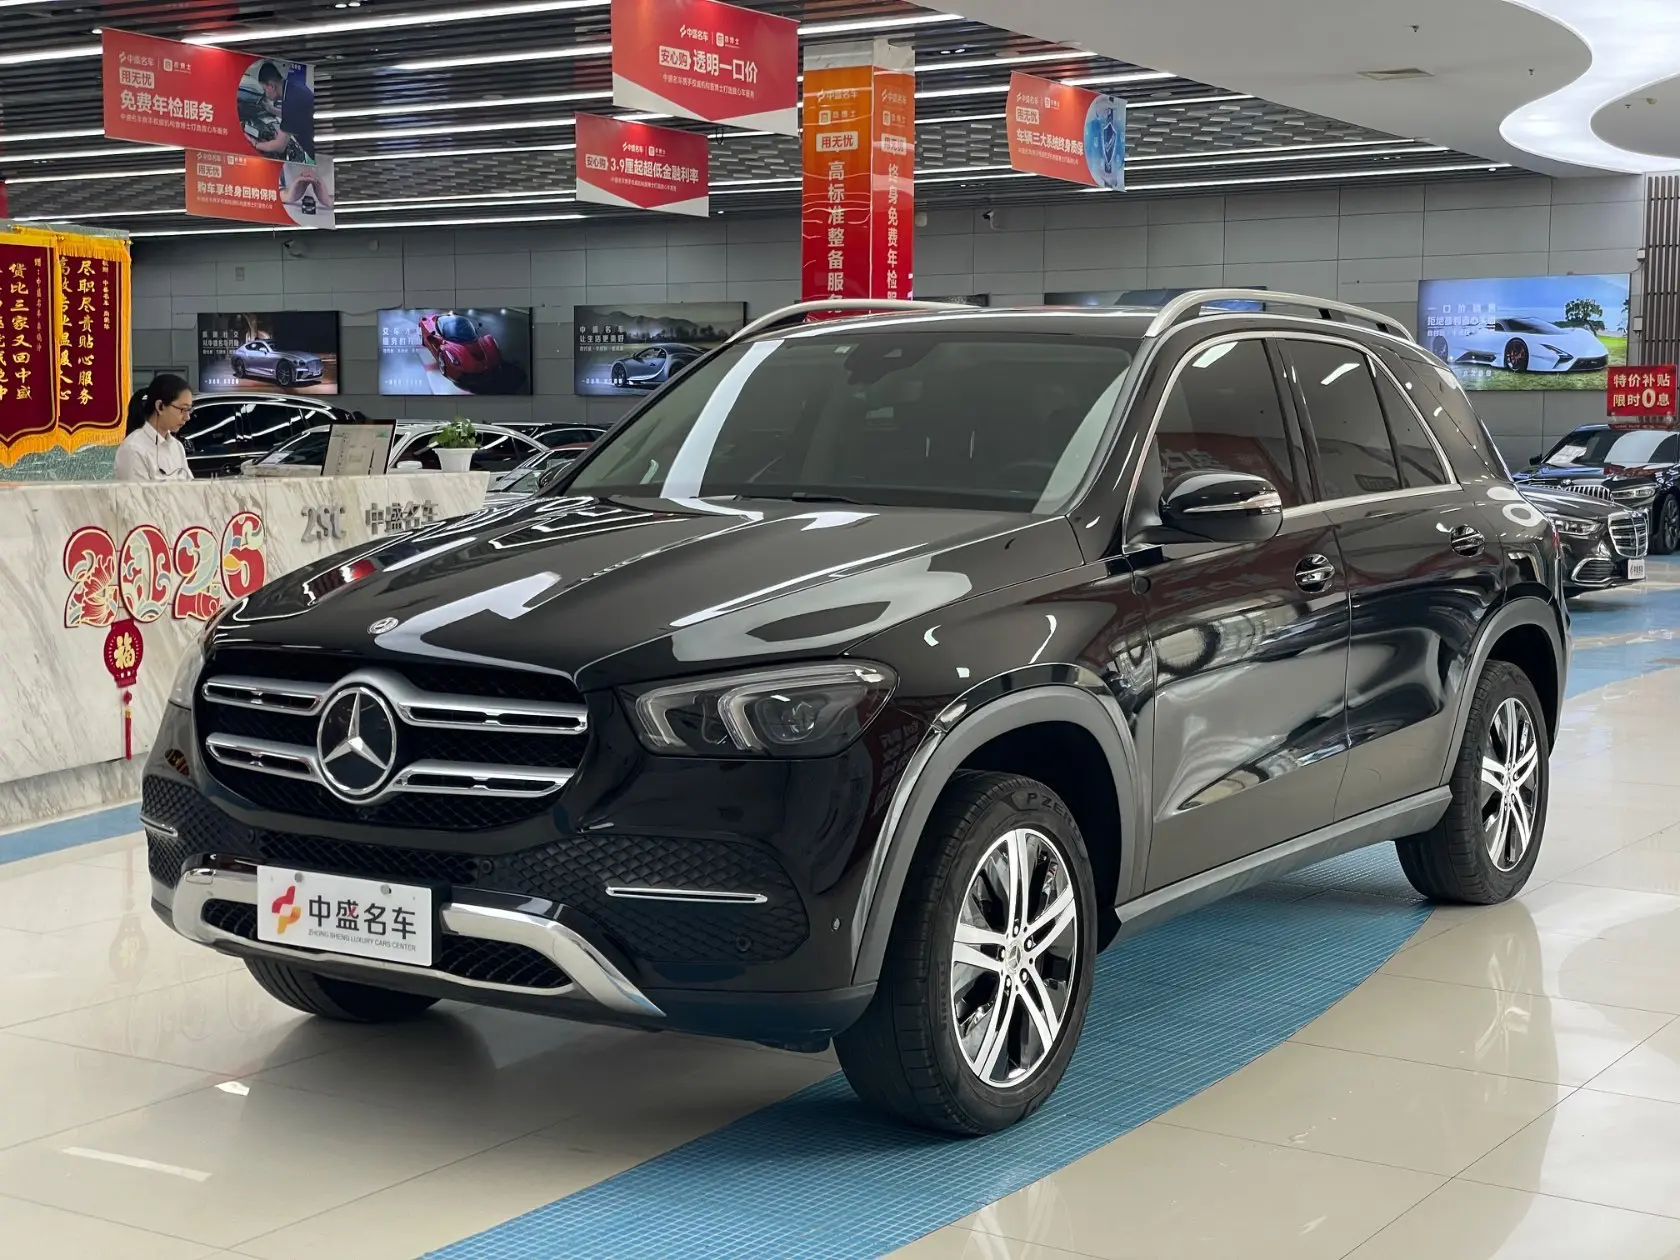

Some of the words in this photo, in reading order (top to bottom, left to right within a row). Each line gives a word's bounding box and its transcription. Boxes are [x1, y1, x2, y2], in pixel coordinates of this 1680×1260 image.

[121, 70, 152, 86] 用无忧
[661, 49, 688, 67] 安心购
[693, 49, 758, 84] 透明一口价
[121, 90, 214, 122] 免费年检服务
[821, 135, 854, 149] 用无忧
[610, 158, 699, 184] 3.9厘起超低金融利率
[1613, 373, 1671, 388] 特价补贴
[1613, 388, 1670, 408] 限时0息
[113, 631, 136, 669] 福
[308, 895, 417, 940] 中盛名车
[308, 929, 330, 938] ZHONG
[329, 932, 350, 942] SHENG
[350, 935, 374, 946] LUXURY
[374, 939, 391, 948] CARS
[391, 941, 417, 952] CENTER
